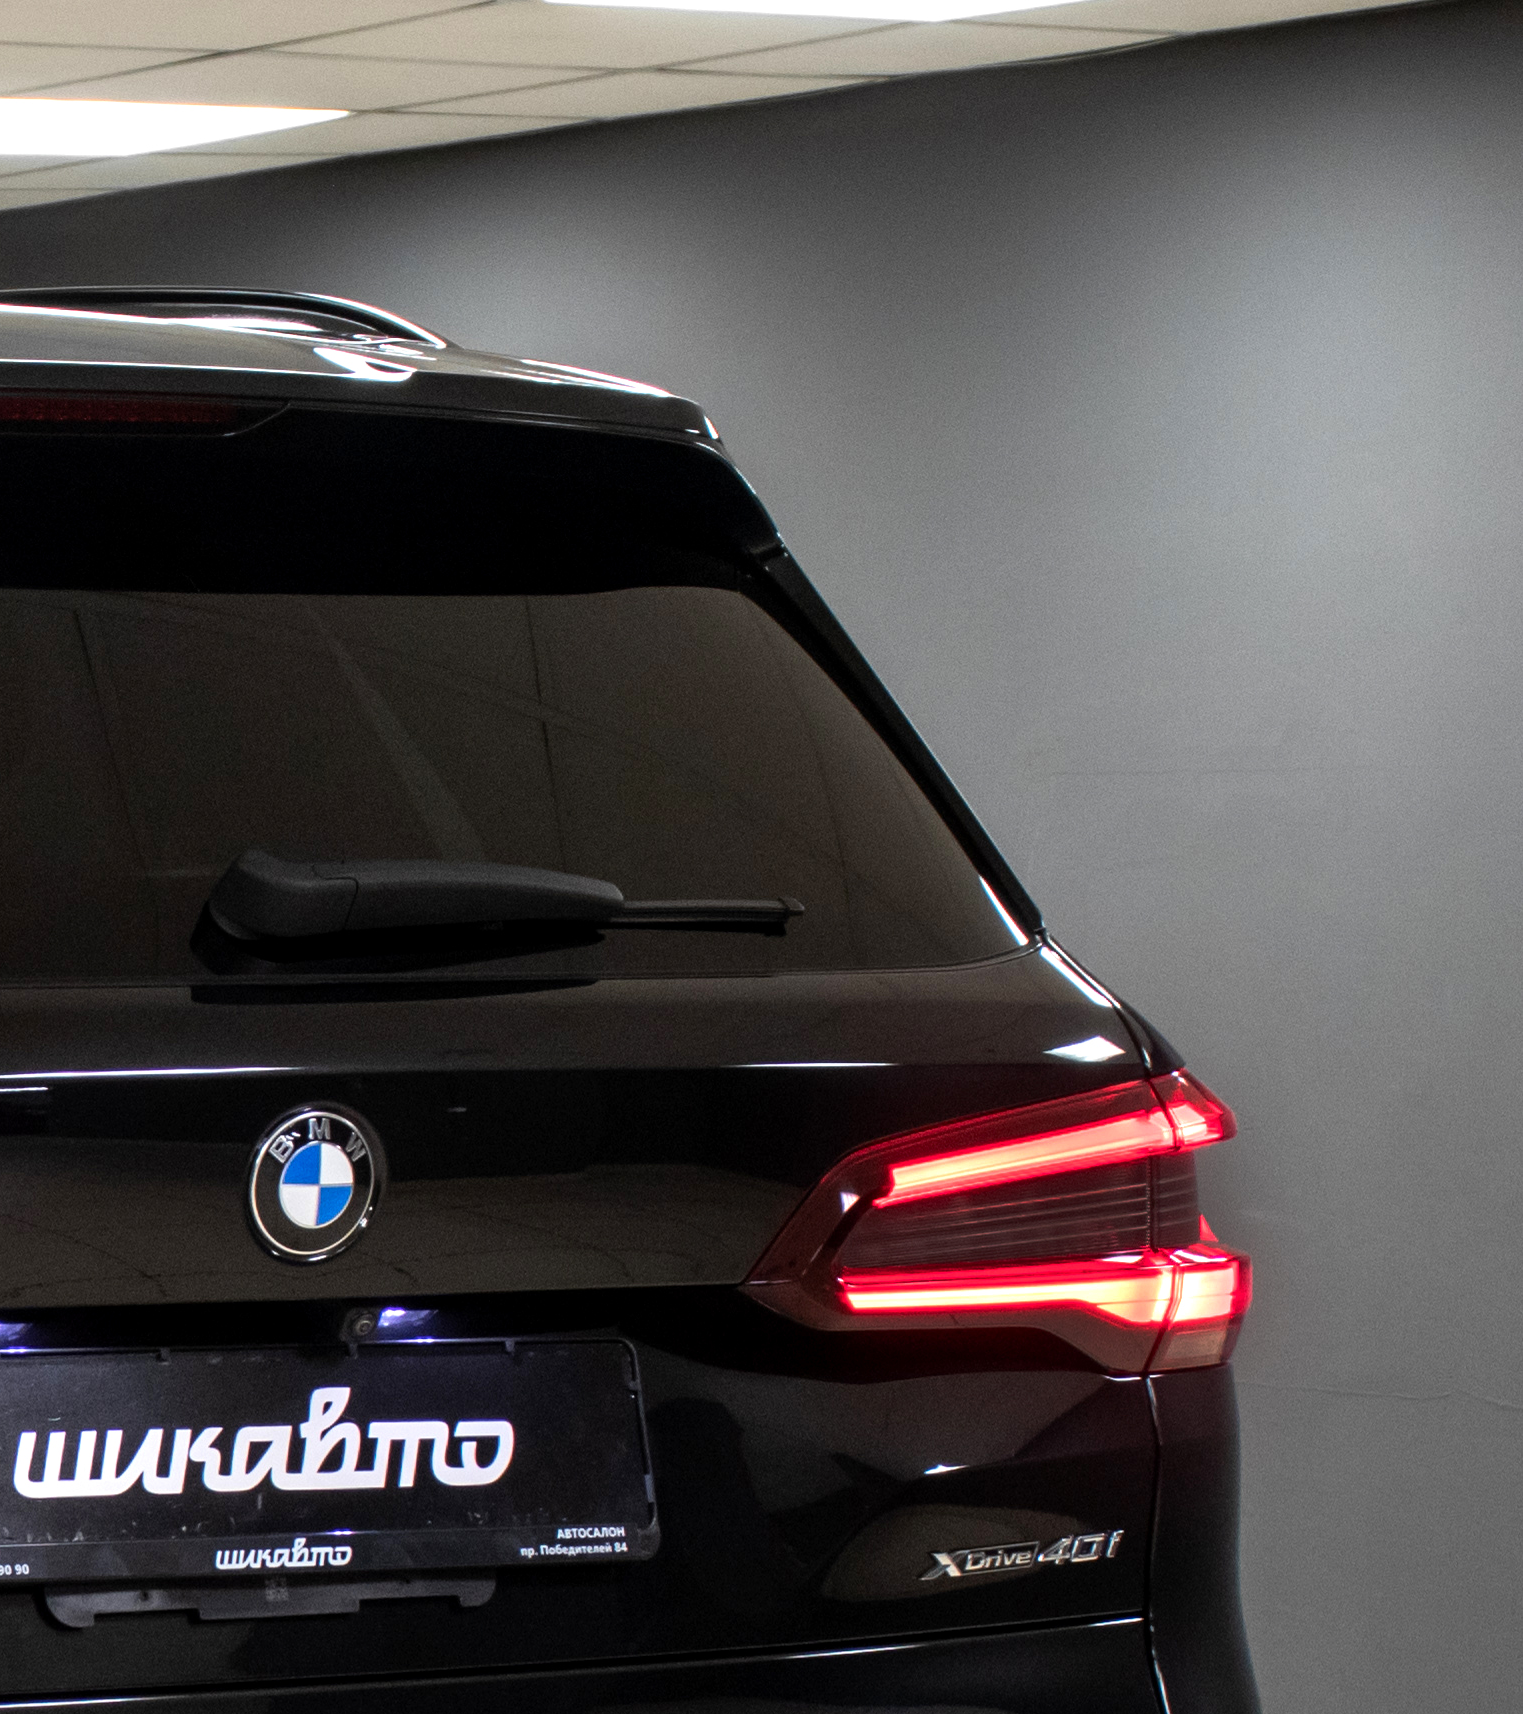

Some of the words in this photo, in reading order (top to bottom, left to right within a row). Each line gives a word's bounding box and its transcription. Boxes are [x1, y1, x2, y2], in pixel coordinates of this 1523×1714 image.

[269, 1117, 367, 1164] BMW
[557, 1526, 626, 1539] АВТОСАЛОН
[520, 1547, 538, 1558] пр.
[540, 1542, 612, 1557] Победителей
[614, 1542, 628, 1553] 84
[14, 1563, 30, 1575] 90
